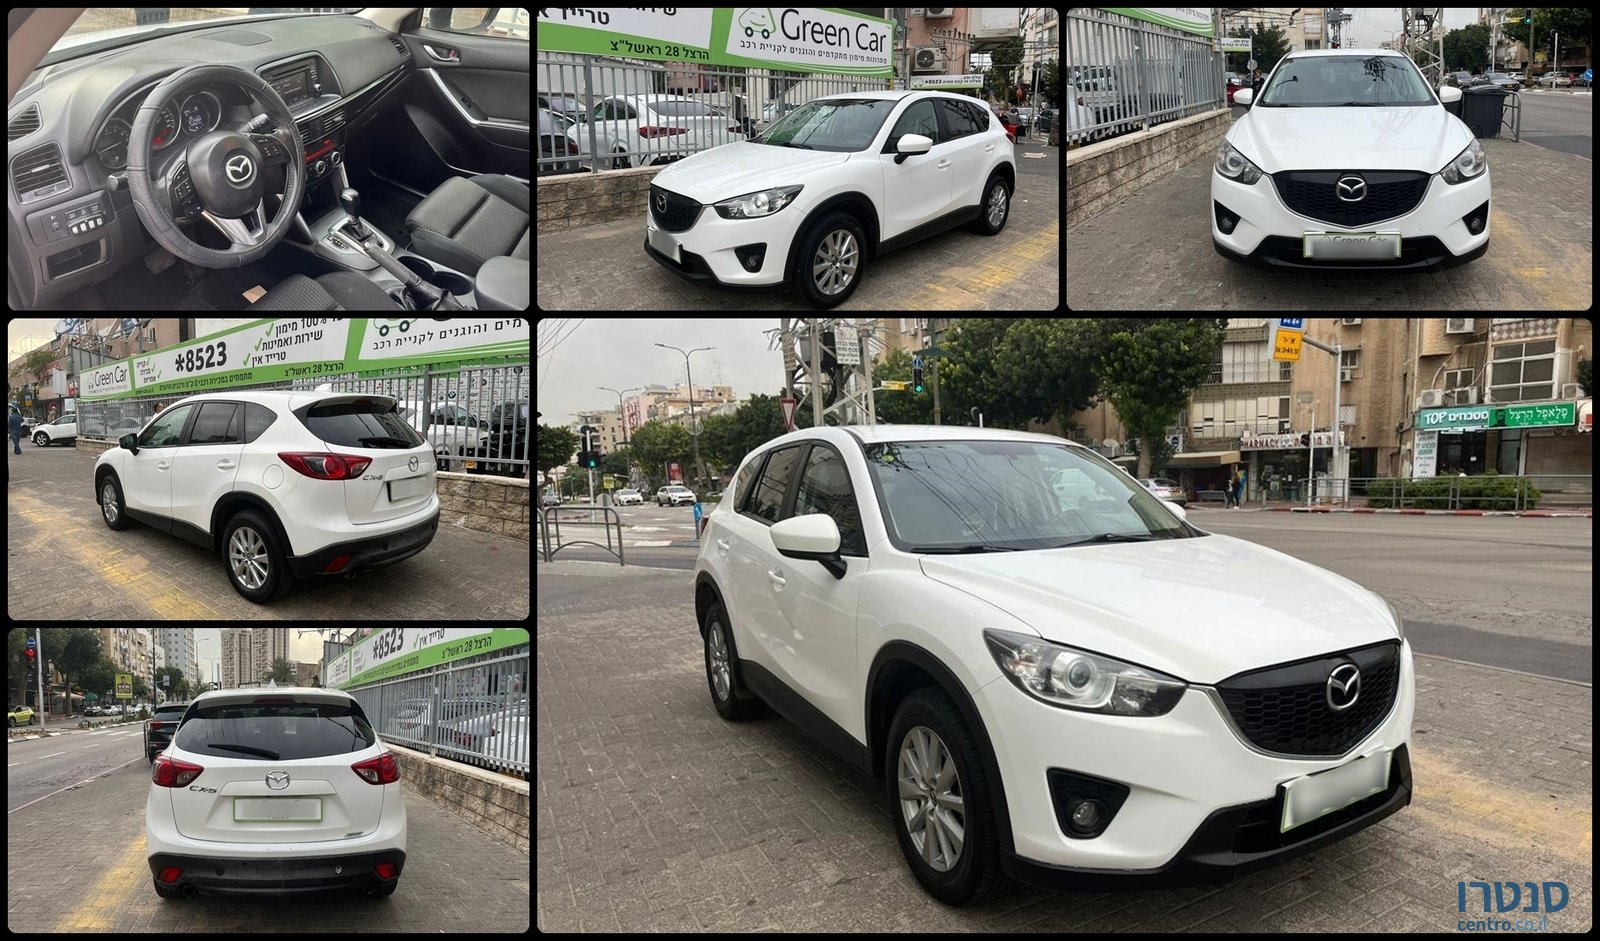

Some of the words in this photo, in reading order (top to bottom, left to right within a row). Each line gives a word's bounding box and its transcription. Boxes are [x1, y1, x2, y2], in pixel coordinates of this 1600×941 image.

[780, 8, 850, 48] Green
[855, 23, 886, 53] Car
[665, 45, 680, 57] 28
[740, 40, 757, 49] רכב
[759, 42, 787, 54] לקניית
[683, 46, 709, 60] הרצל
[275, 321, 298, 338] מימון
[439, 323, 487, 340] והוגנים
[294, 329, 323, 345] שירות
[395, 332, 434, 347] לקניית
[261, 337, 293, 351] ואמינות
[373, 340, 391, 350] רכב
[252, 356, 263, 368] אין
[264, 351, 286, 363] טרייד
[312, 364, 322, 373] 28
[324, 362, 344, 372] הרצל
[94, 371, 114, 387] Green
[114, 366, 127, 383] Car
[1424, 411, 1448, 425] TOP
[464, 640, 473, 653] 28
[474, 636, 492, 650] הרצל
[189, 785, 218, 794] CX-5
